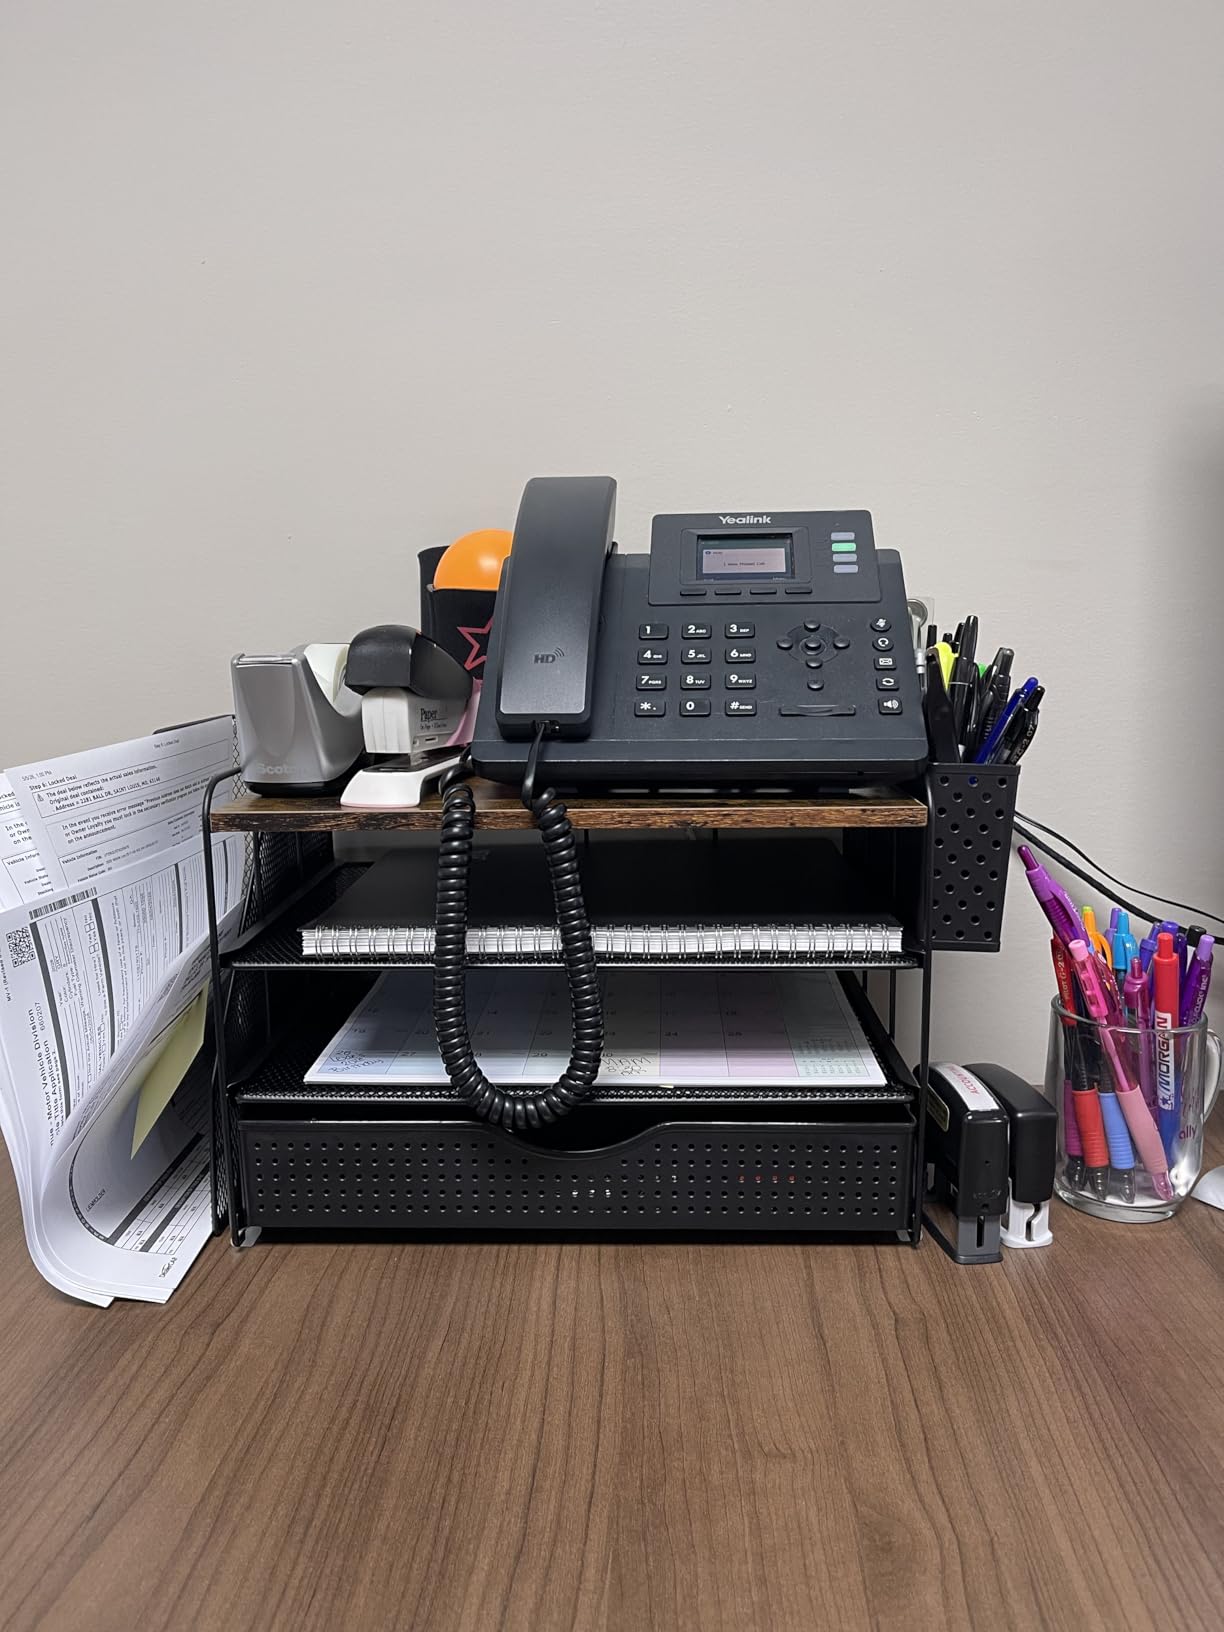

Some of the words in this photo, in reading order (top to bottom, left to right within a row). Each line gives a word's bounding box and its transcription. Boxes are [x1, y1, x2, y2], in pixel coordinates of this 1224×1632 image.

[719, 515, 771, 524] Yealink
[645, 626, 651, 634] 1
[688, 625, 695, 633] 2
[730, 624, 737, 632] 3
[643, 650, 651, 658] 4
[688, 650, 695, 658] 5
[730, 649, 738, 657] 6
[534, 654, 556, 664] HD
[642, 676, 649, 684] 7
[686, 676, 694, 684] 8
[730, 674, 738, 683] 9
[686, 702, 694, 710] 0
[48, 777, 65, 786] Locked
[66, 774, 77, 782] Deal
[68, 785, 82, 793] below
[83, 780, 100, 789] reflects
[109, 773, 122, 781] actual
[50, 794, 69, 805] Original
[80, 786, 104, 797] contained:
[55, 802, 75, 811] Address
[78, 818, 91, 826] event
[92, 815, 100, 824] you
[100, 810, 116, 818] receive
[117, 806, 127, 814] error
[71, 827, 86, 835] Owner
[87, 821, 104, 832] Loyalty
[6, 857, 24, 866] Vehicle
[28, 1009, 40, 1050] Division
[1157, 1016, 1170, 1091] MORGAN
[38, 1052, 48, 1090] Vehicle
[44, 1040, 57, 1095] Application
[1178, 1125, 1197, 1140] ally
